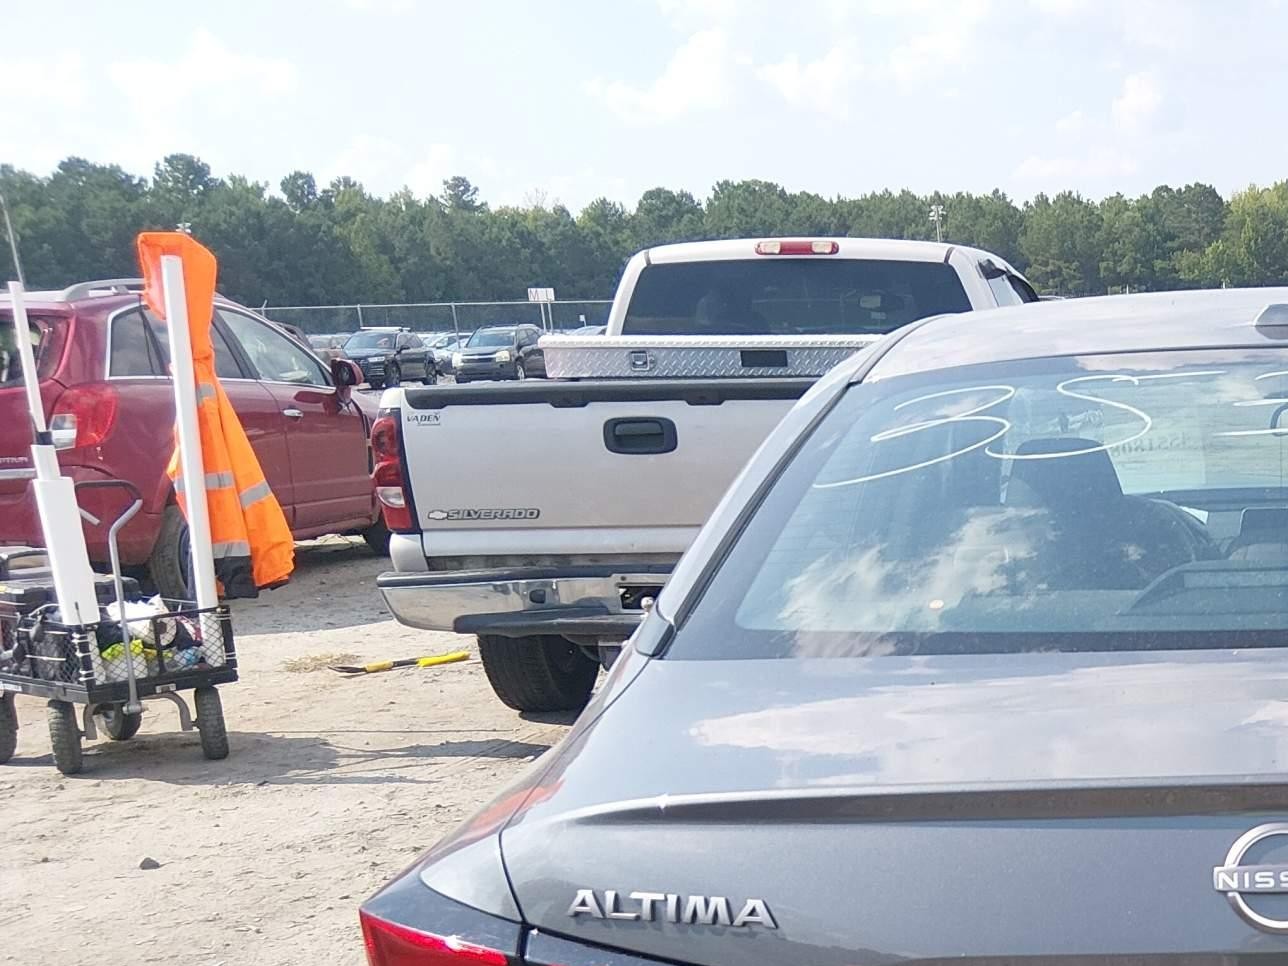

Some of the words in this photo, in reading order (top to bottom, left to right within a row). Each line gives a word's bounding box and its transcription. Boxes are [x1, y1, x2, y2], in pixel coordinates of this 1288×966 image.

[406, 413, 441, 423] VADEN
[446, 508, 541, 520] SILVERADO
[566, 888, 778, 930] ALTIMA
